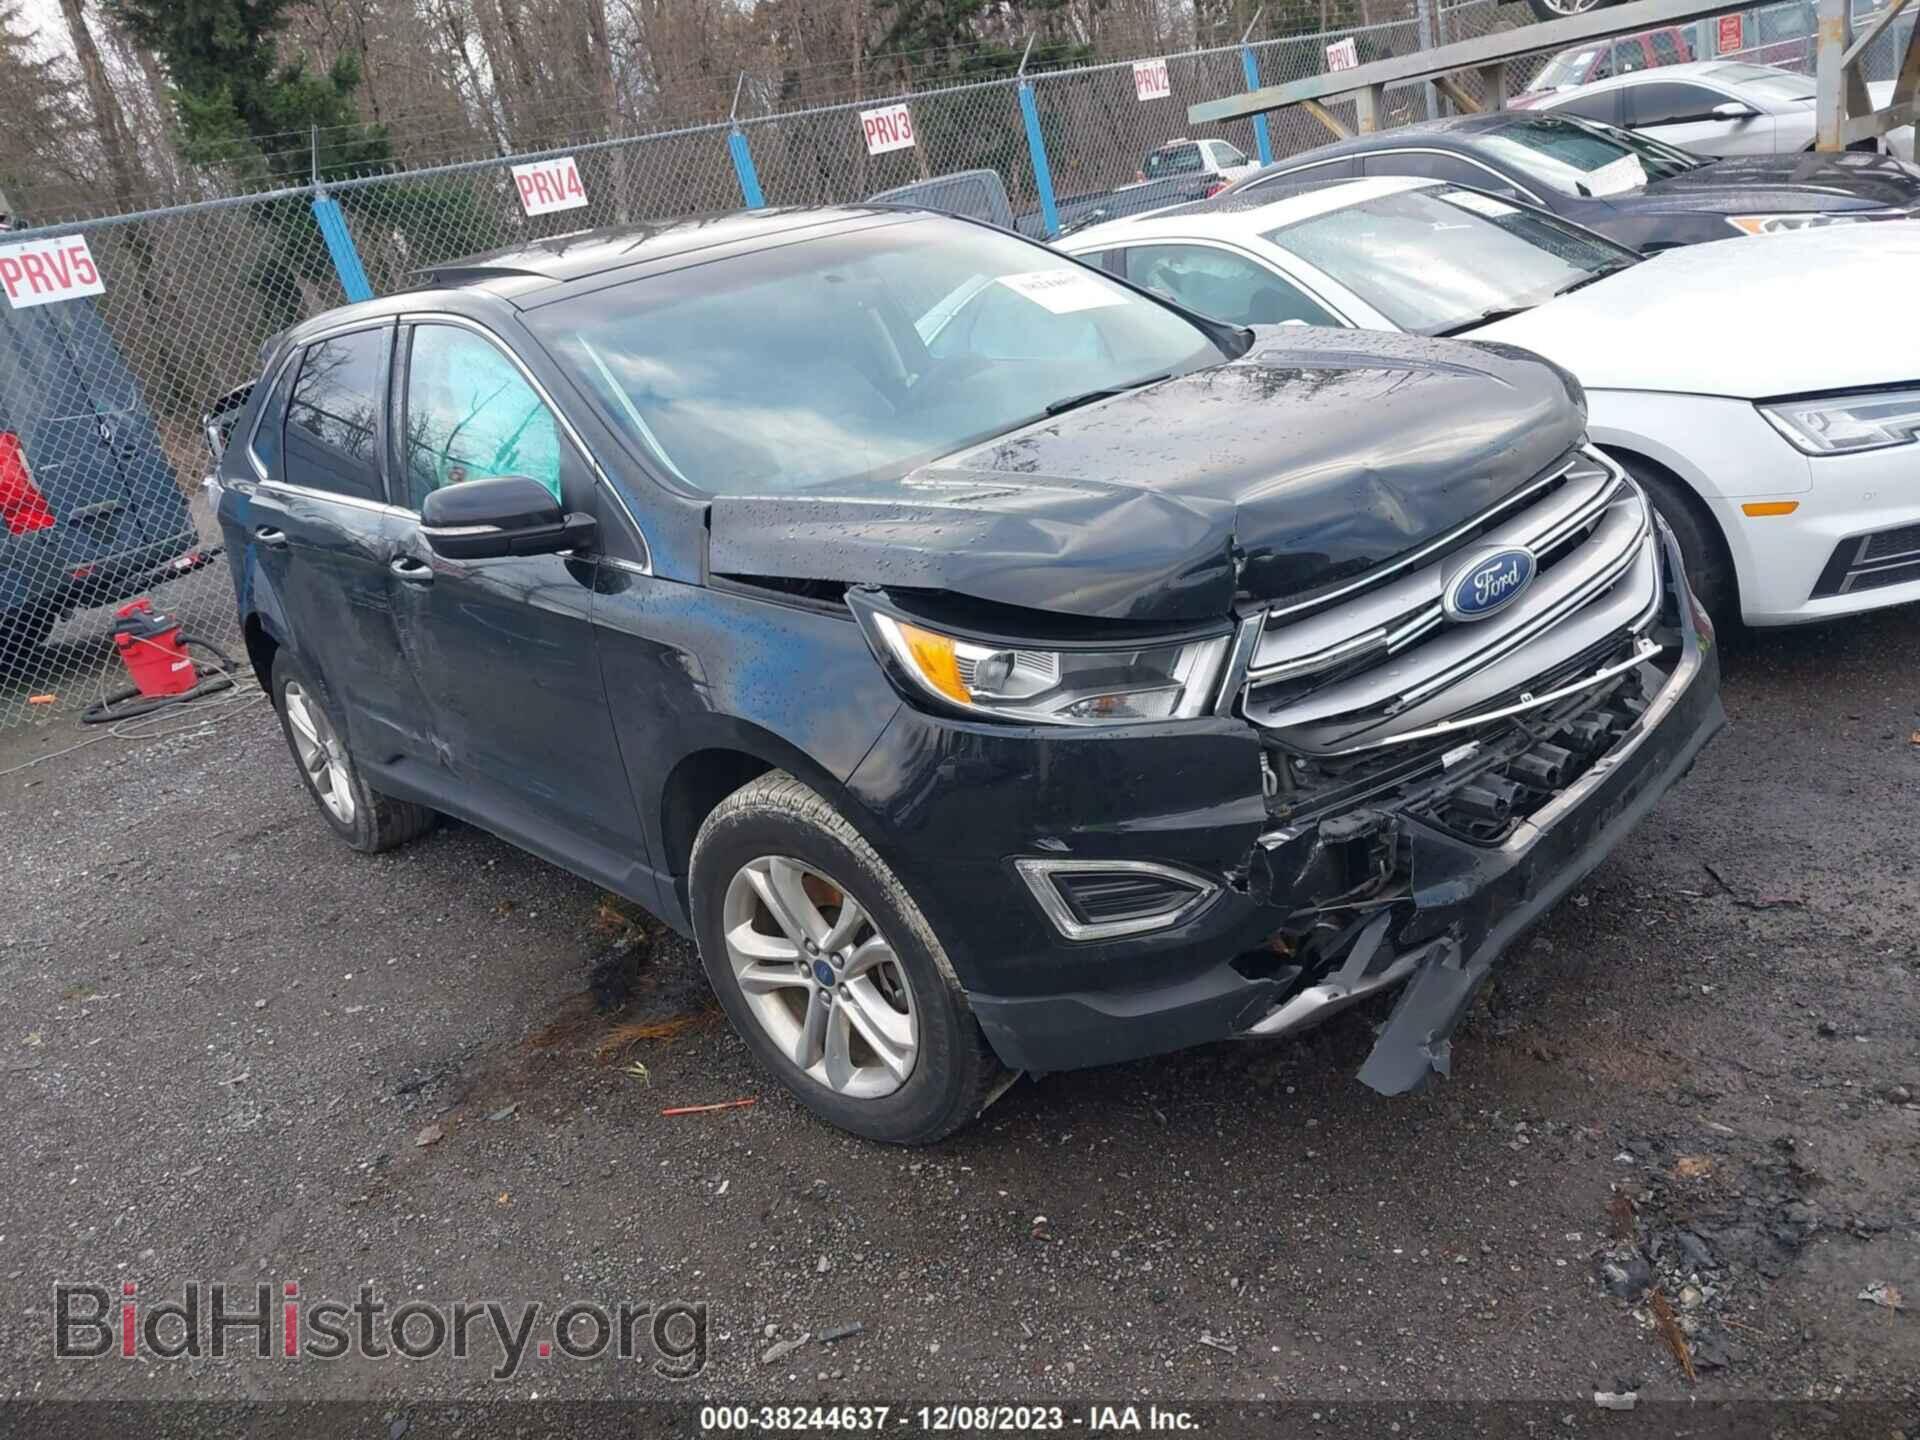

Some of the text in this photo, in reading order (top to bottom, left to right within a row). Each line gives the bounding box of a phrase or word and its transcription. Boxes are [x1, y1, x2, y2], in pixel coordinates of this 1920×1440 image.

[1135, 66, 1169, 94] PRV2
[864, 112, 911, 147] PRV3
[516, 165, 583, 207] PRV4
[0, 245, 97, 298] PRV5
[1474, 559, 1520, 605] Ford
